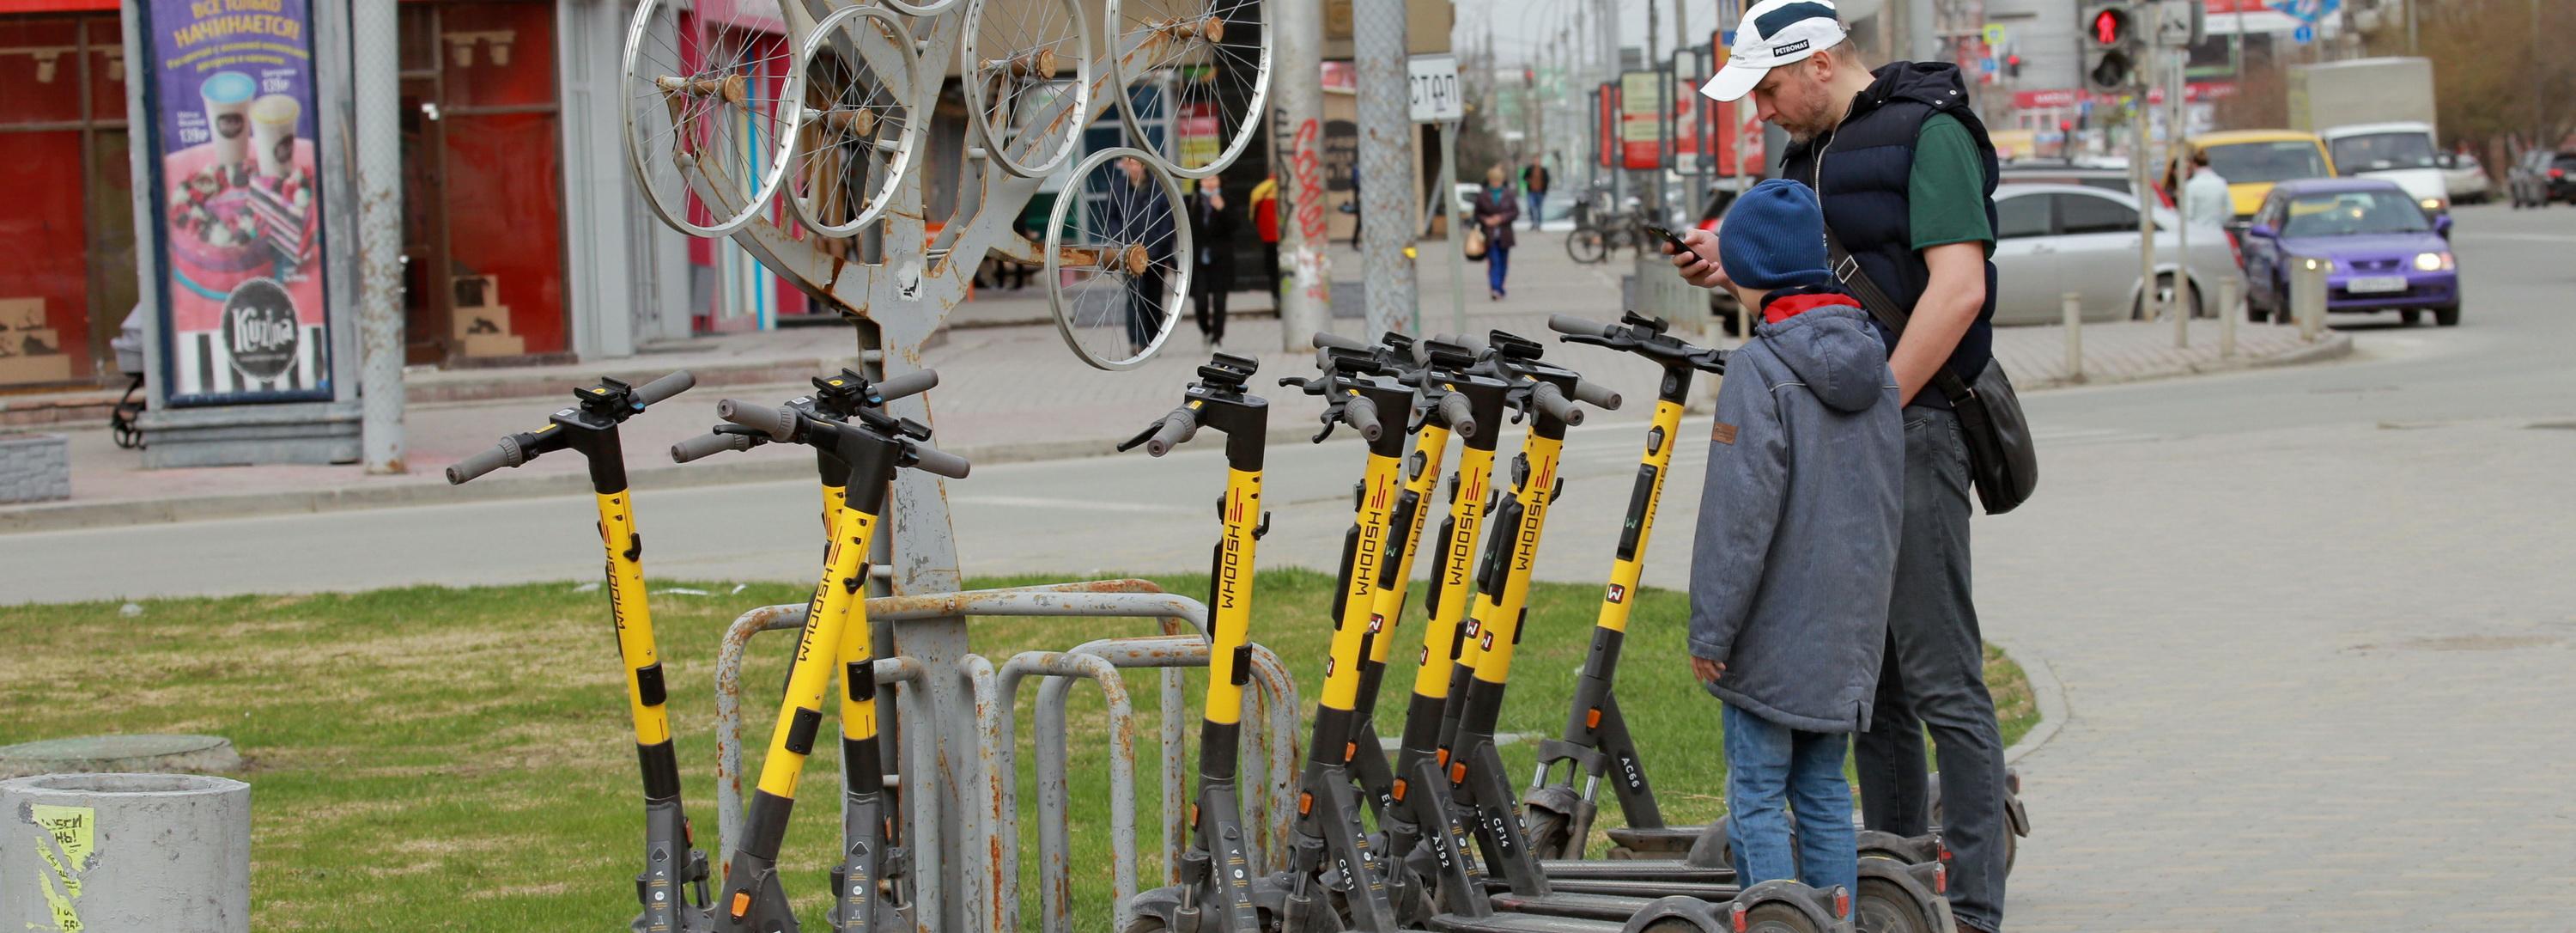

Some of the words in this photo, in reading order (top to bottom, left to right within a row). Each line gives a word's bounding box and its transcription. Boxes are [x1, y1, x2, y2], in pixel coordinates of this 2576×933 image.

[173, 14, 301, 49] НАЧИНАЕТСЯ!
[1774, 40, 1808, 56] PETRONAS
[233, 307, 295, 354] Kuzina
[1449, 503, 1476, 585] WHOOSH
[1515, 491, 1545, 570] WHOOSH
[1221, 524, 1241, 600] WHOOSH
[1355, 511, 1382, 595] WHOOSH
[605, 546, 626, 631] WHOOSH
[1607, 586, 1624, 601] W
[798, 568, 834, 662] WHOOSH
[1621, 758, 1640, 788] AC66
[1432, 836, 1449, 869] AJ92
[1493, 818, 1510, 848] CF14
[1340, 859, 1355, 890] CK51
